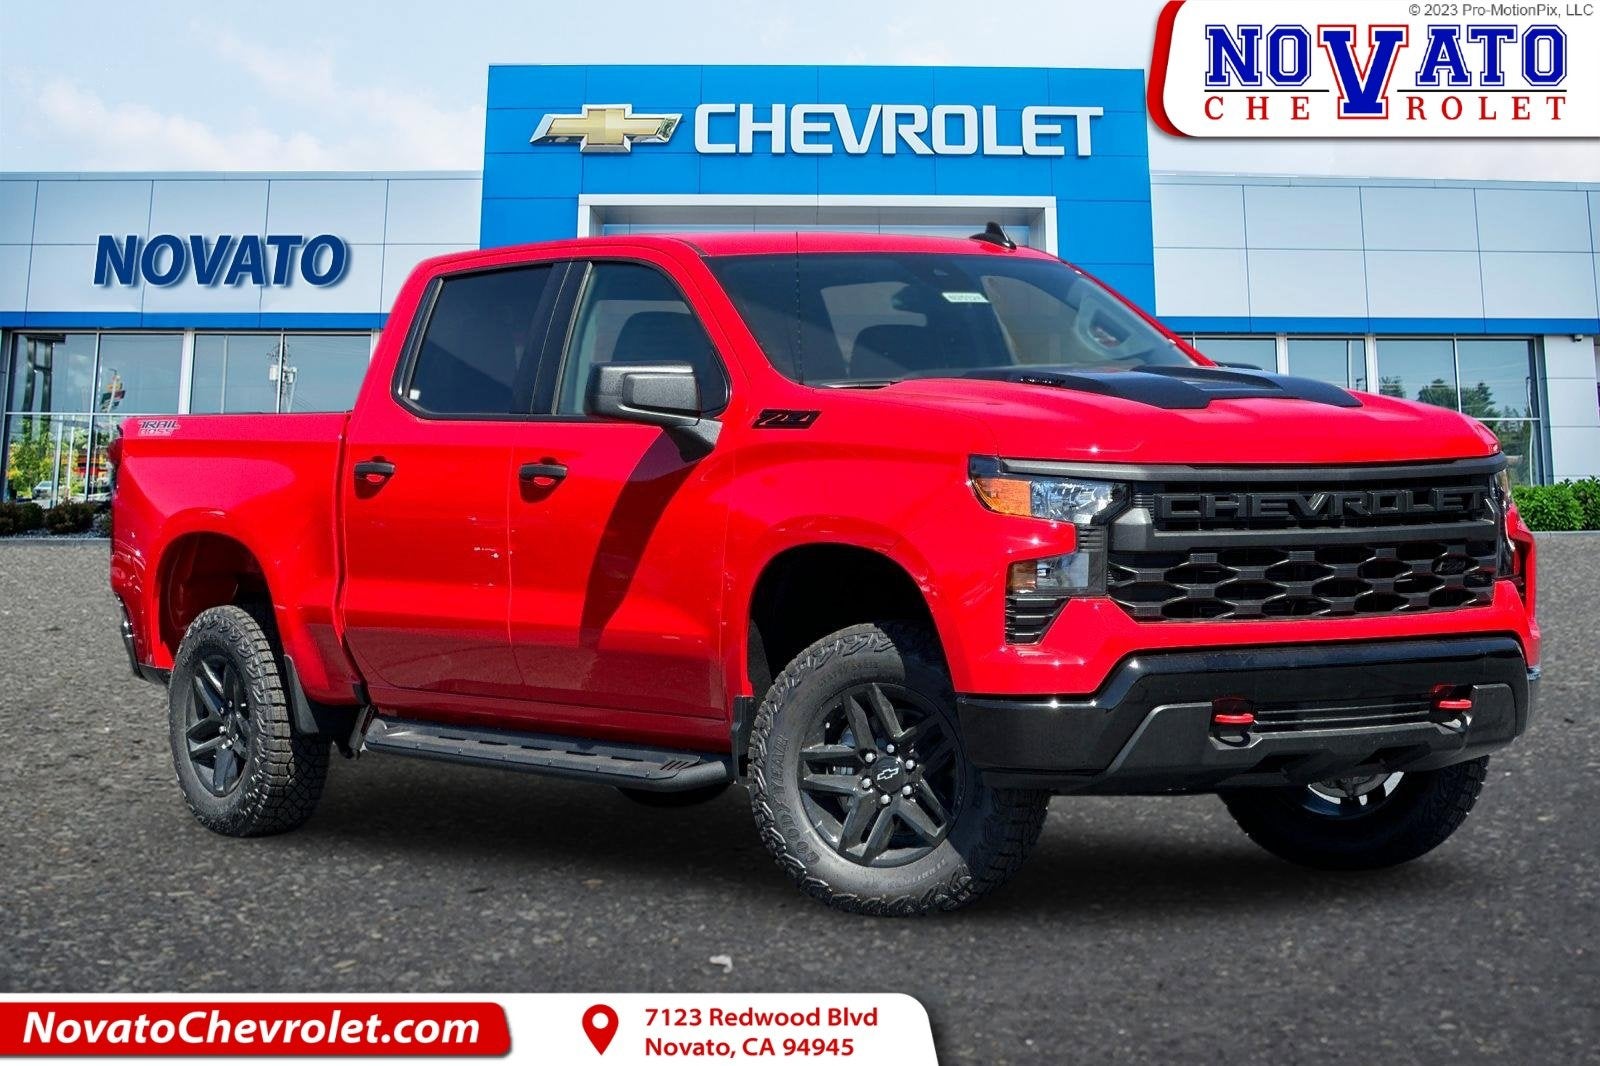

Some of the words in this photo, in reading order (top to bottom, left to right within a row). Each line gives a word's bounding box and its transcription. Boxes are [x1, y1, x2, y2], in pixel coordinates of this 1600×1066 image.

[694, 103, 1104, 157] CHEVROLET
[93, 234, 349, 287] NOVATO
[1155, 489, 1489, 520] CHEVROLET
